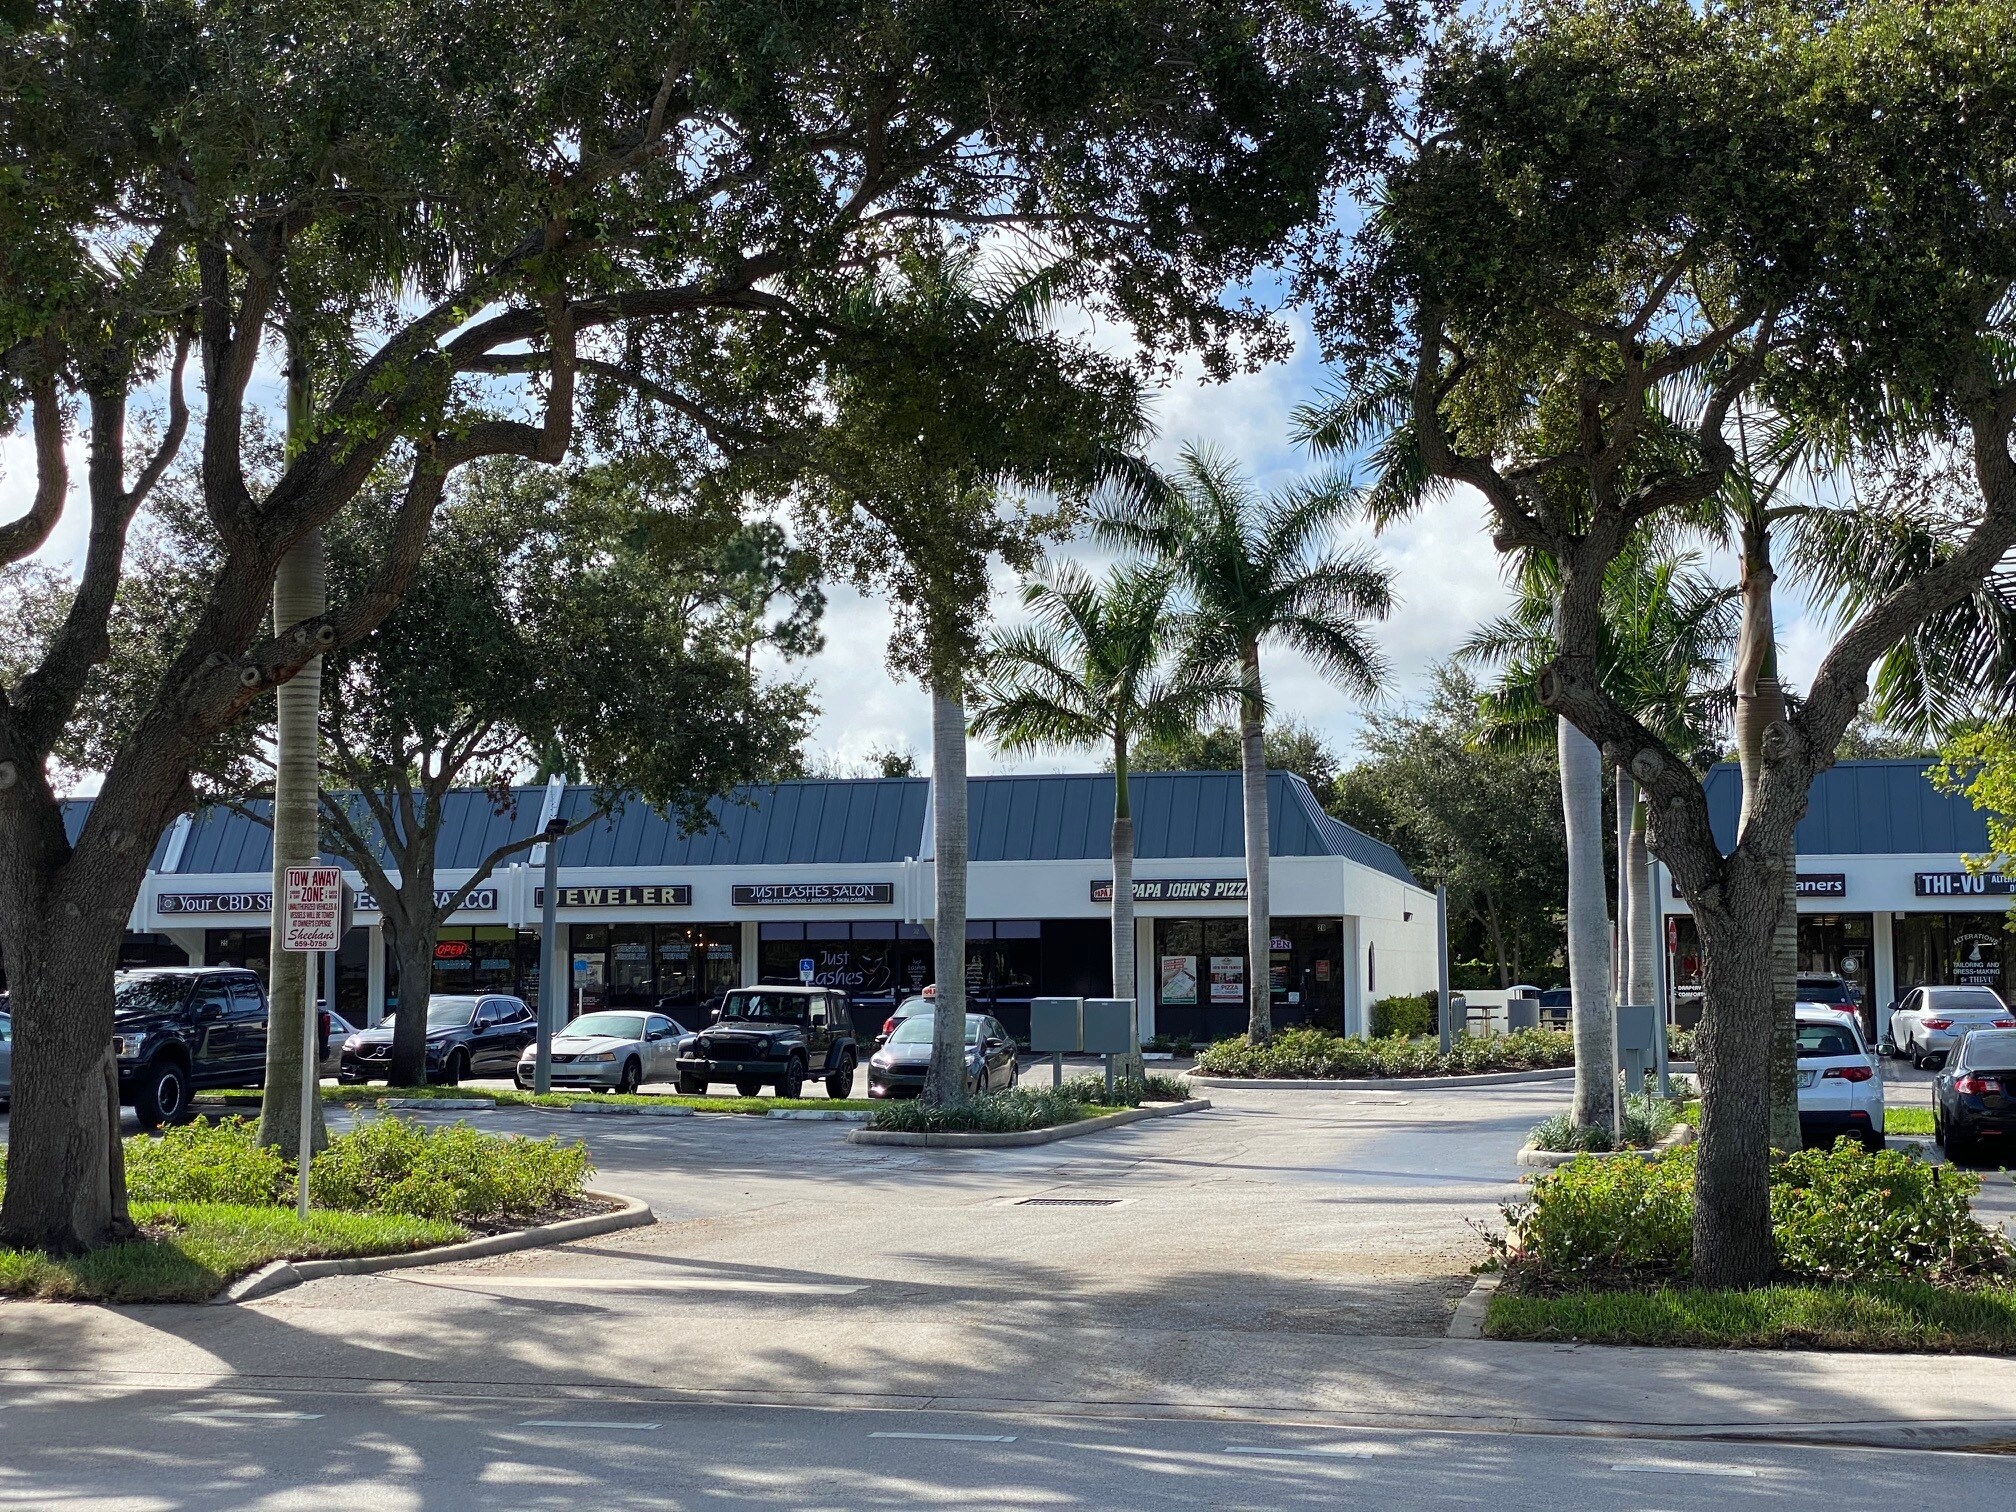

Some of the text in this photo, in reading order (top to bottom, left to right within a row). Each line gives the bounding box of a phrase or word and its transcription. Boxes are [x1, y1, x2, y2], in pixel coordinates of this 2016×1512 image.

[289, 871, 338, 887] TOW AWAY
[1796, 880, 1842, 892] aners
[1922, 875, 1985, 893] THI-VU
[301, 887, 325, 902] ZONE
[750, 884, 874, 898] JUST LASHES SALON
[1131, 882, 1249, 898] PAPA JOHN'S PIZZ
[178, 894, 272, 911] Your CBD St
[287, 928, 334, 941] Sheehan's
[1953, 933, 1999, 946] ALTERATIONS
[437, 945, 464, 955] OPEN
[1269, 940, 1290, 948] PEN
[820, 951, 850, 965] Just
[808, 966, 864, 985] ashes
